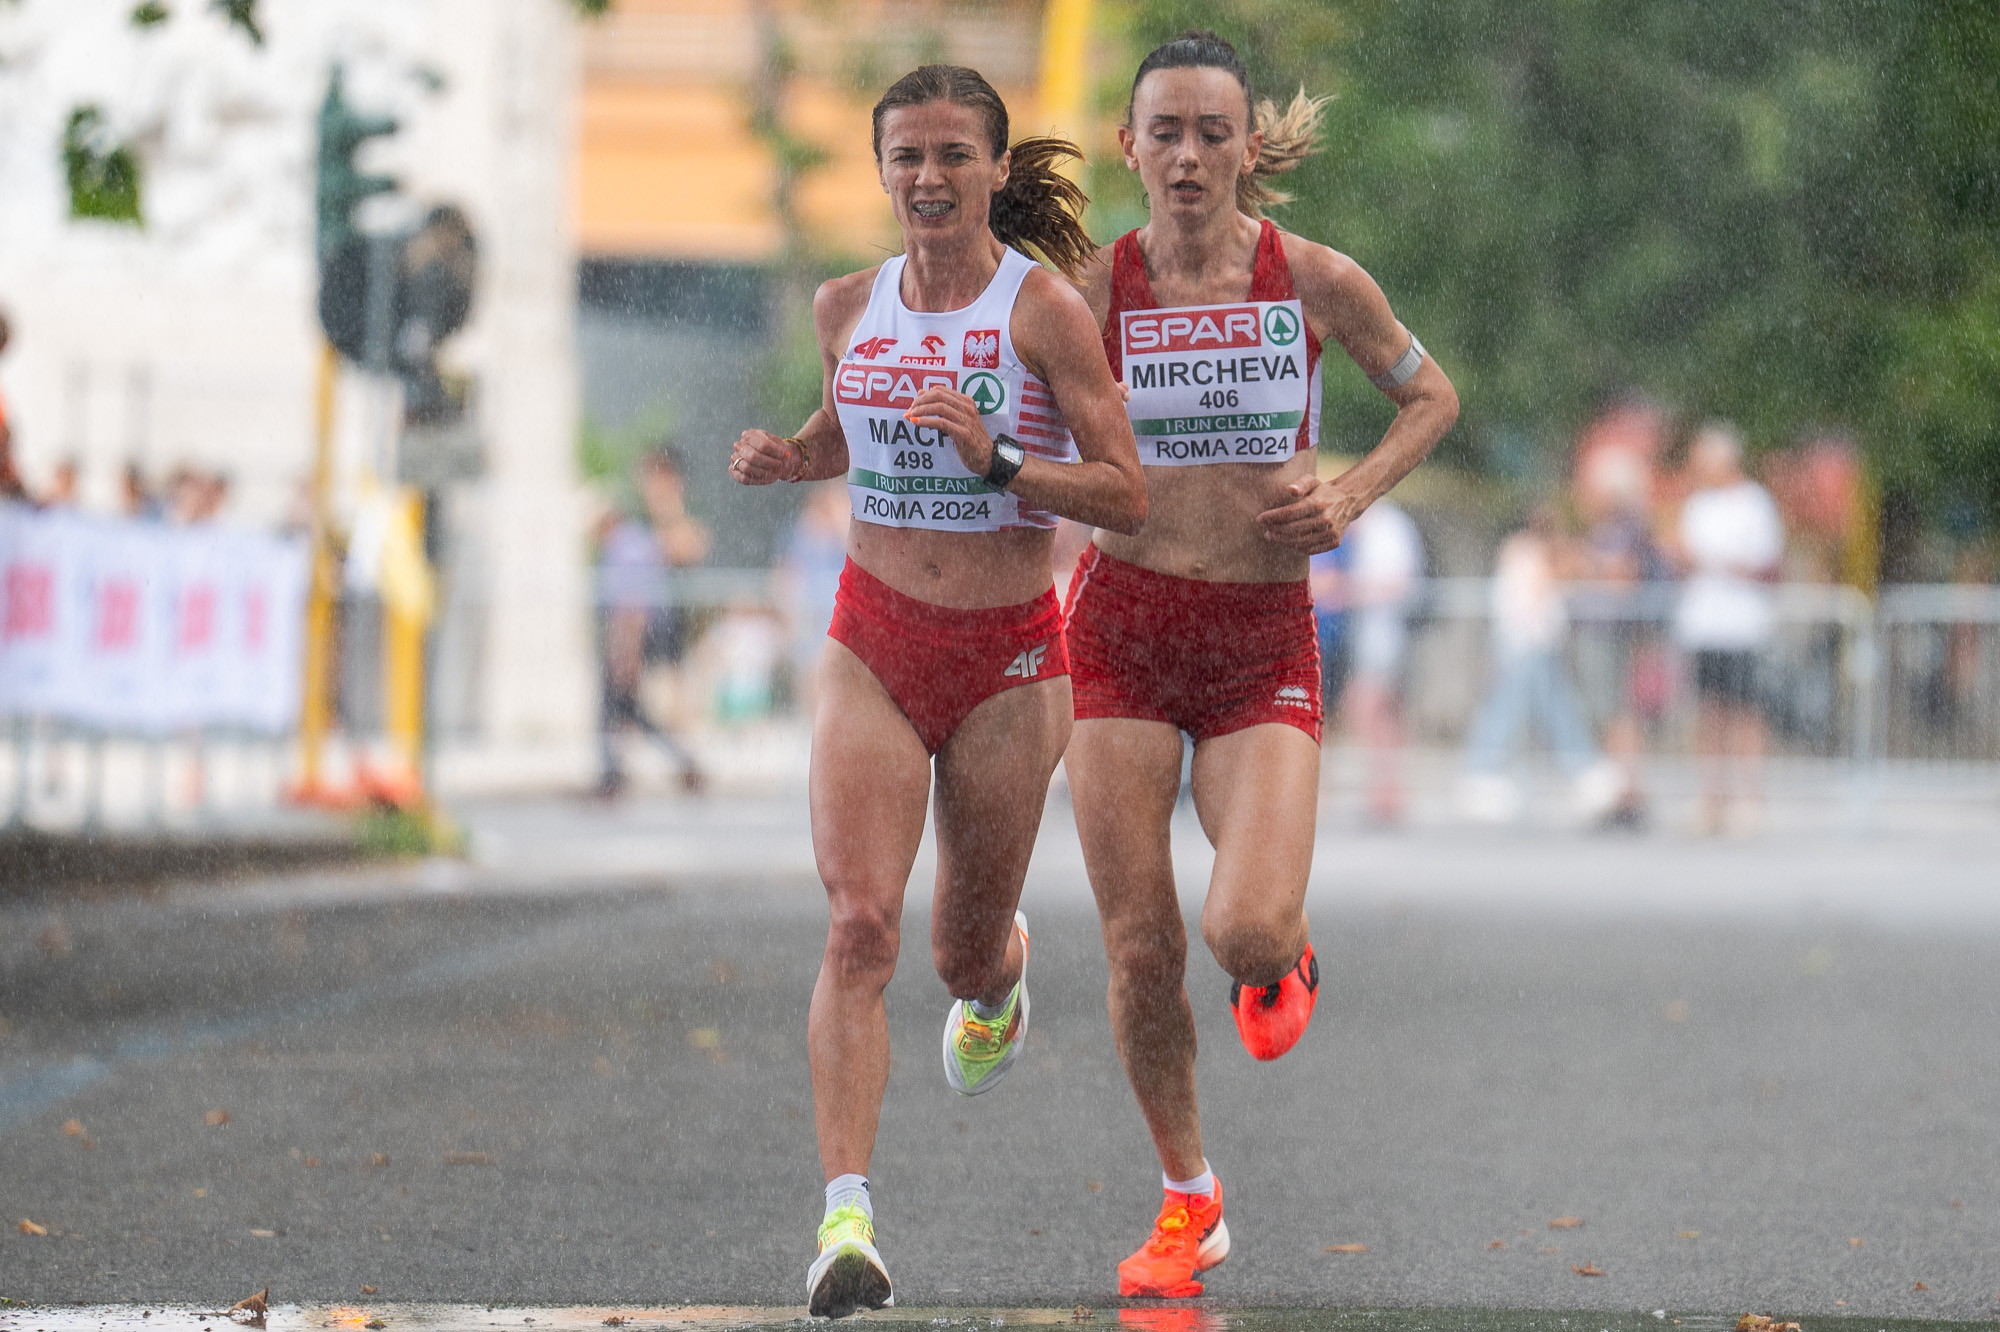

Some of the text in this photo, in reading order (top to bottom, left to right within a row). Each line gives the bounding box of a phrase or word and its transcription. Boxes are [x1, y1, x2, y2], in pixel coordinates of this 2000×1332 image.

[1129, 312, 1257, 349] SPAR
[854, 336, 898, 359] 4F
[1132, 354, 1300, 389] MIRCHEVA
[1199, 389, 1239, 409] 406
[1165, 421, 1170, 433] I
[1174, 418, 1211, 432] RUN
[1156, 435, 1289, 459] ROMA 2024
[893, 450, 934, 470] 498
[875, 475, 879, 488] I
[880, 475, 908, 492] RUN
[863, 495, 991, 520] ROMA 2024
[1003, 643, 1047, 678] 4F
